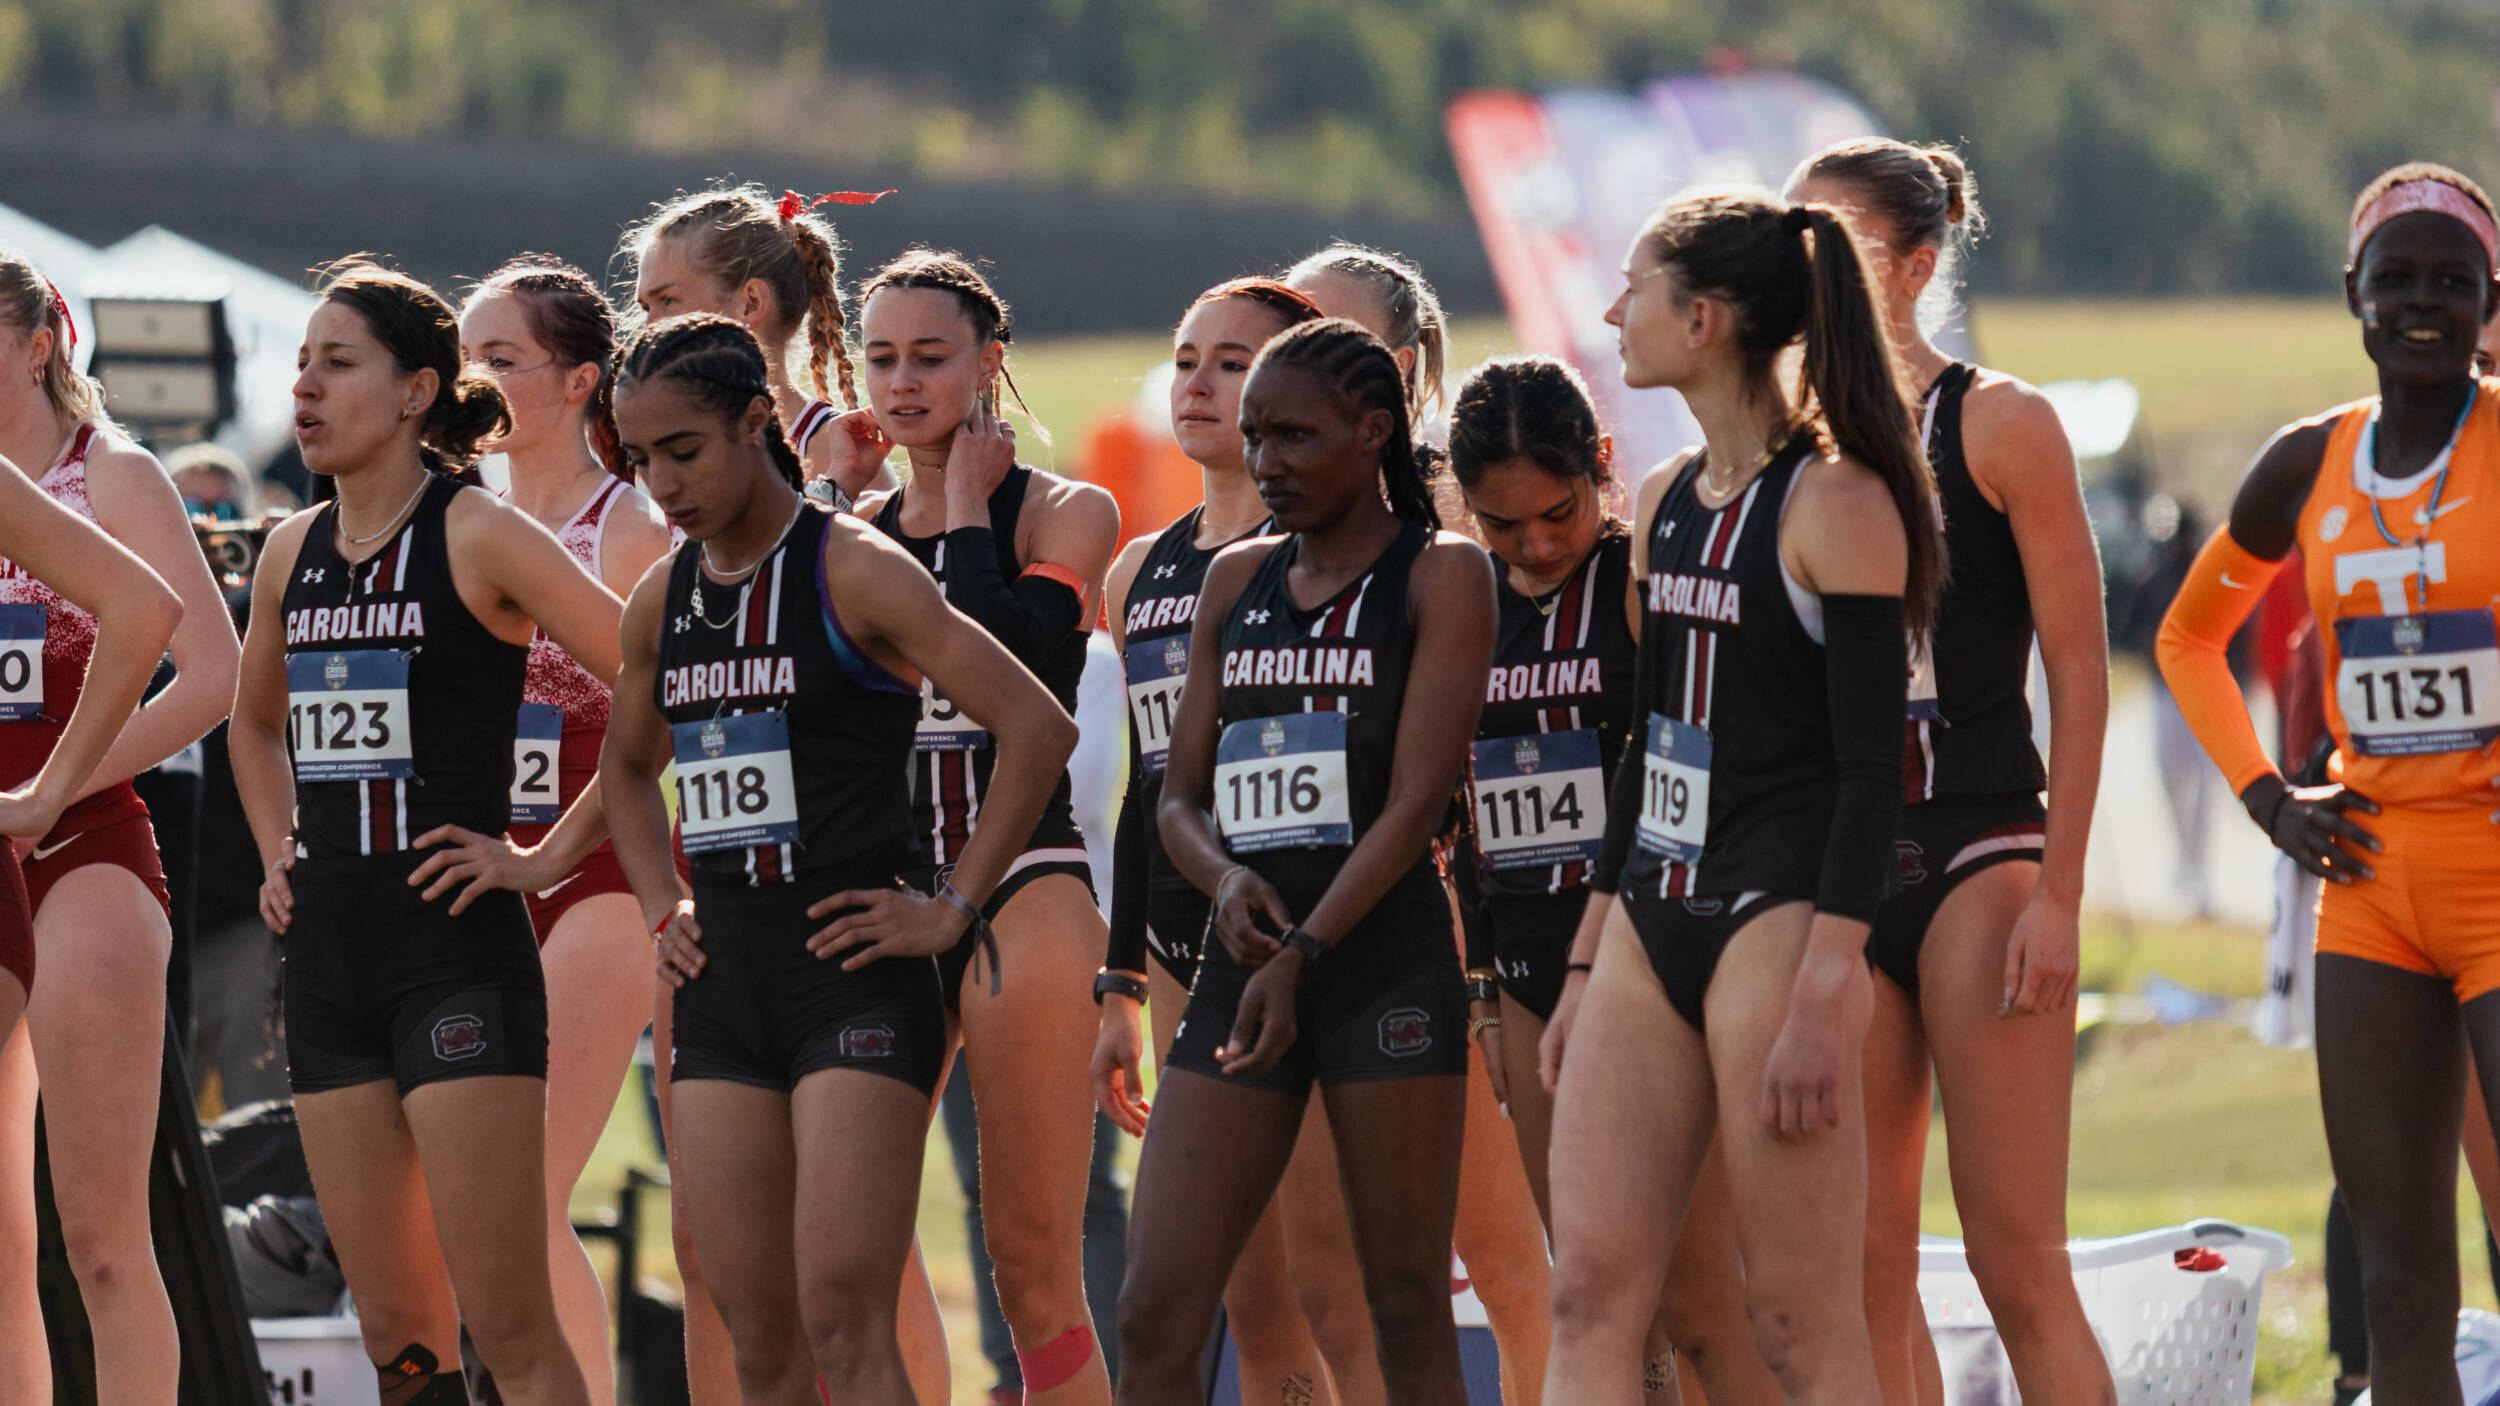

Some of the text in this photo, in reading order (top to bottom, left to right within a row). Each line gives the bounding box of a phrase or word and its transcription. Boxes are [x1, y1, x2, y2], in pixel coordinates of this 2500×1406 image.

[286, 601, 425, 645] CAROLINA
[1648, 572, 1741, 625] AROLINA
[664, 656, 796, 708] CAROLINA
[1223, 648, 1375, 688] CAROLINA
[2355, 666, 2475, 722] 1131
[292, 701, 390, 751] 1123
[1139, 686, 1183, 740] 11
[511, 750, 550, 793] 2
[675, 766, 770, 823] 1118
[1228, 764, 1321, 822] 1116
[1481, 781, 1584, 840] 1114
